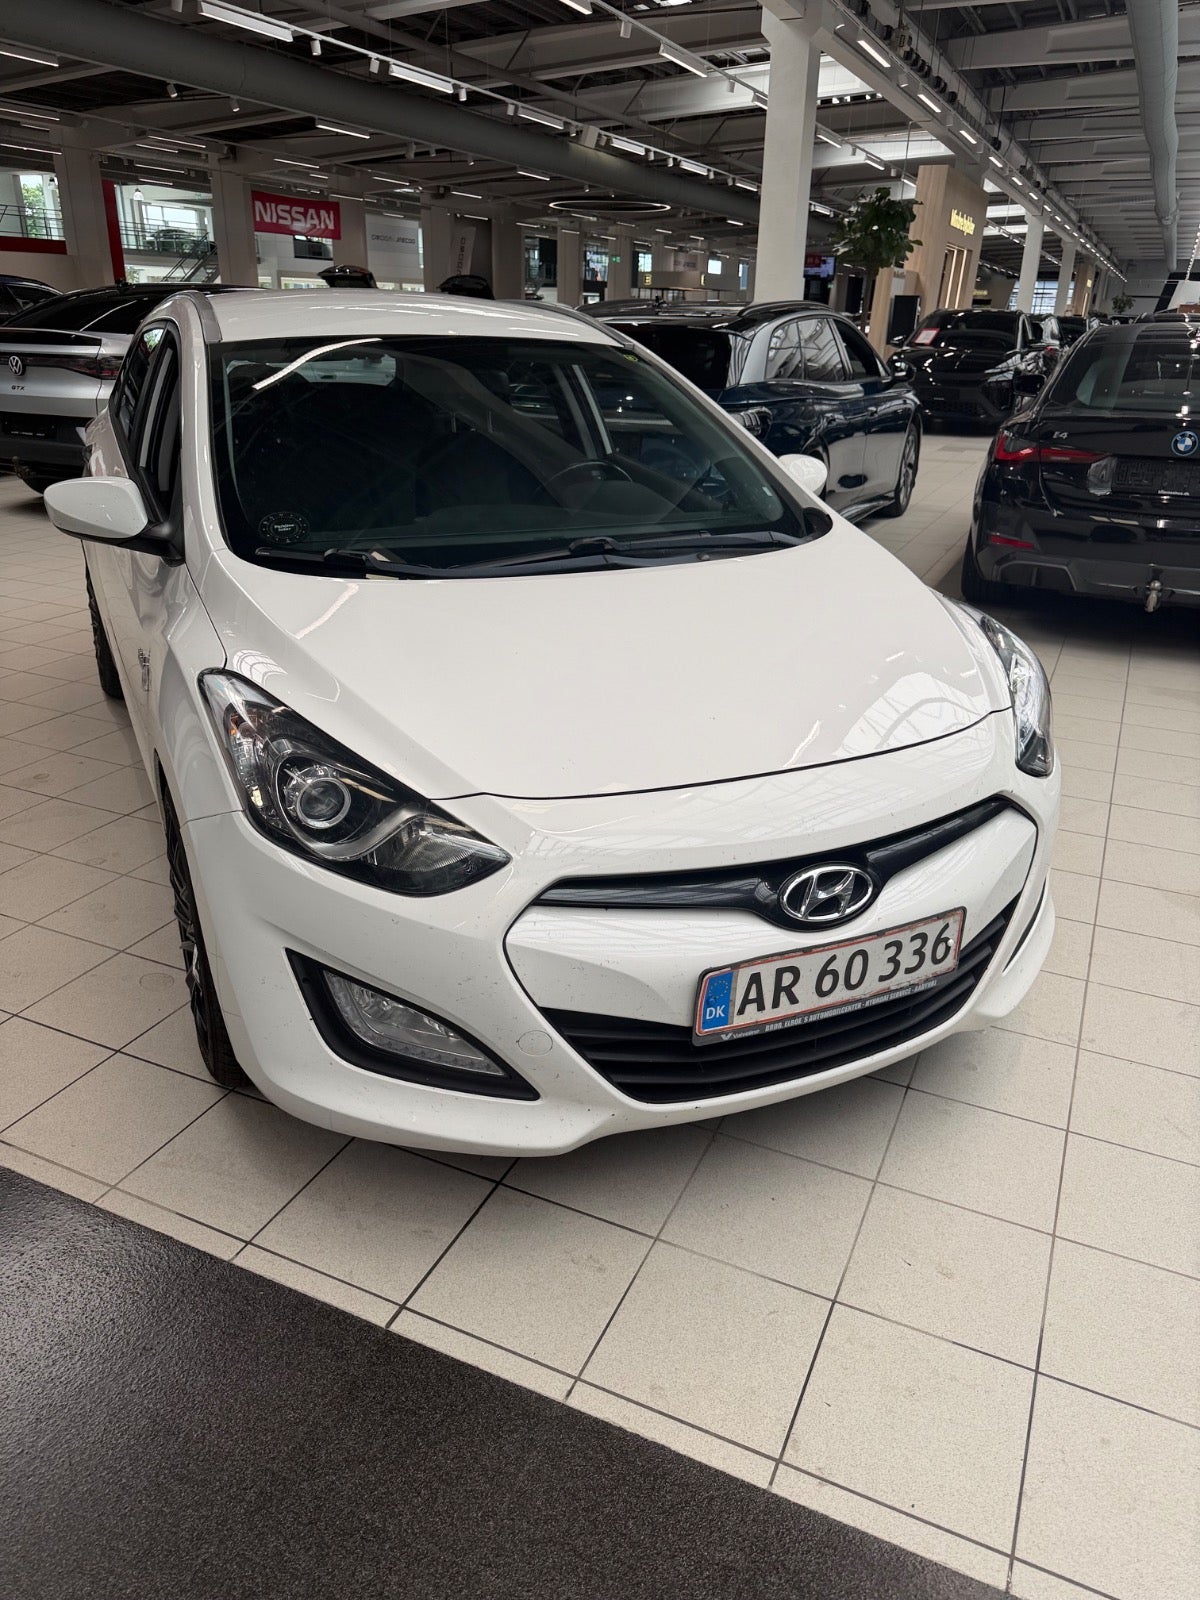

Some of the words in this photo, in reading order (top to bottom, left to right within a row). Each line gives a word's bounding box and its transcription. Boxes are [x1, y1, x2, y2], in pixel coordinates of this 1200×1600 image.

[255, 201, 335, 230] NISSAN
[737, 965, 800, 1016] AR
[814, 949, 869, 998] 60
[878, 922, 950, 982] 336
[705, 1005, 725, 1020] DK
